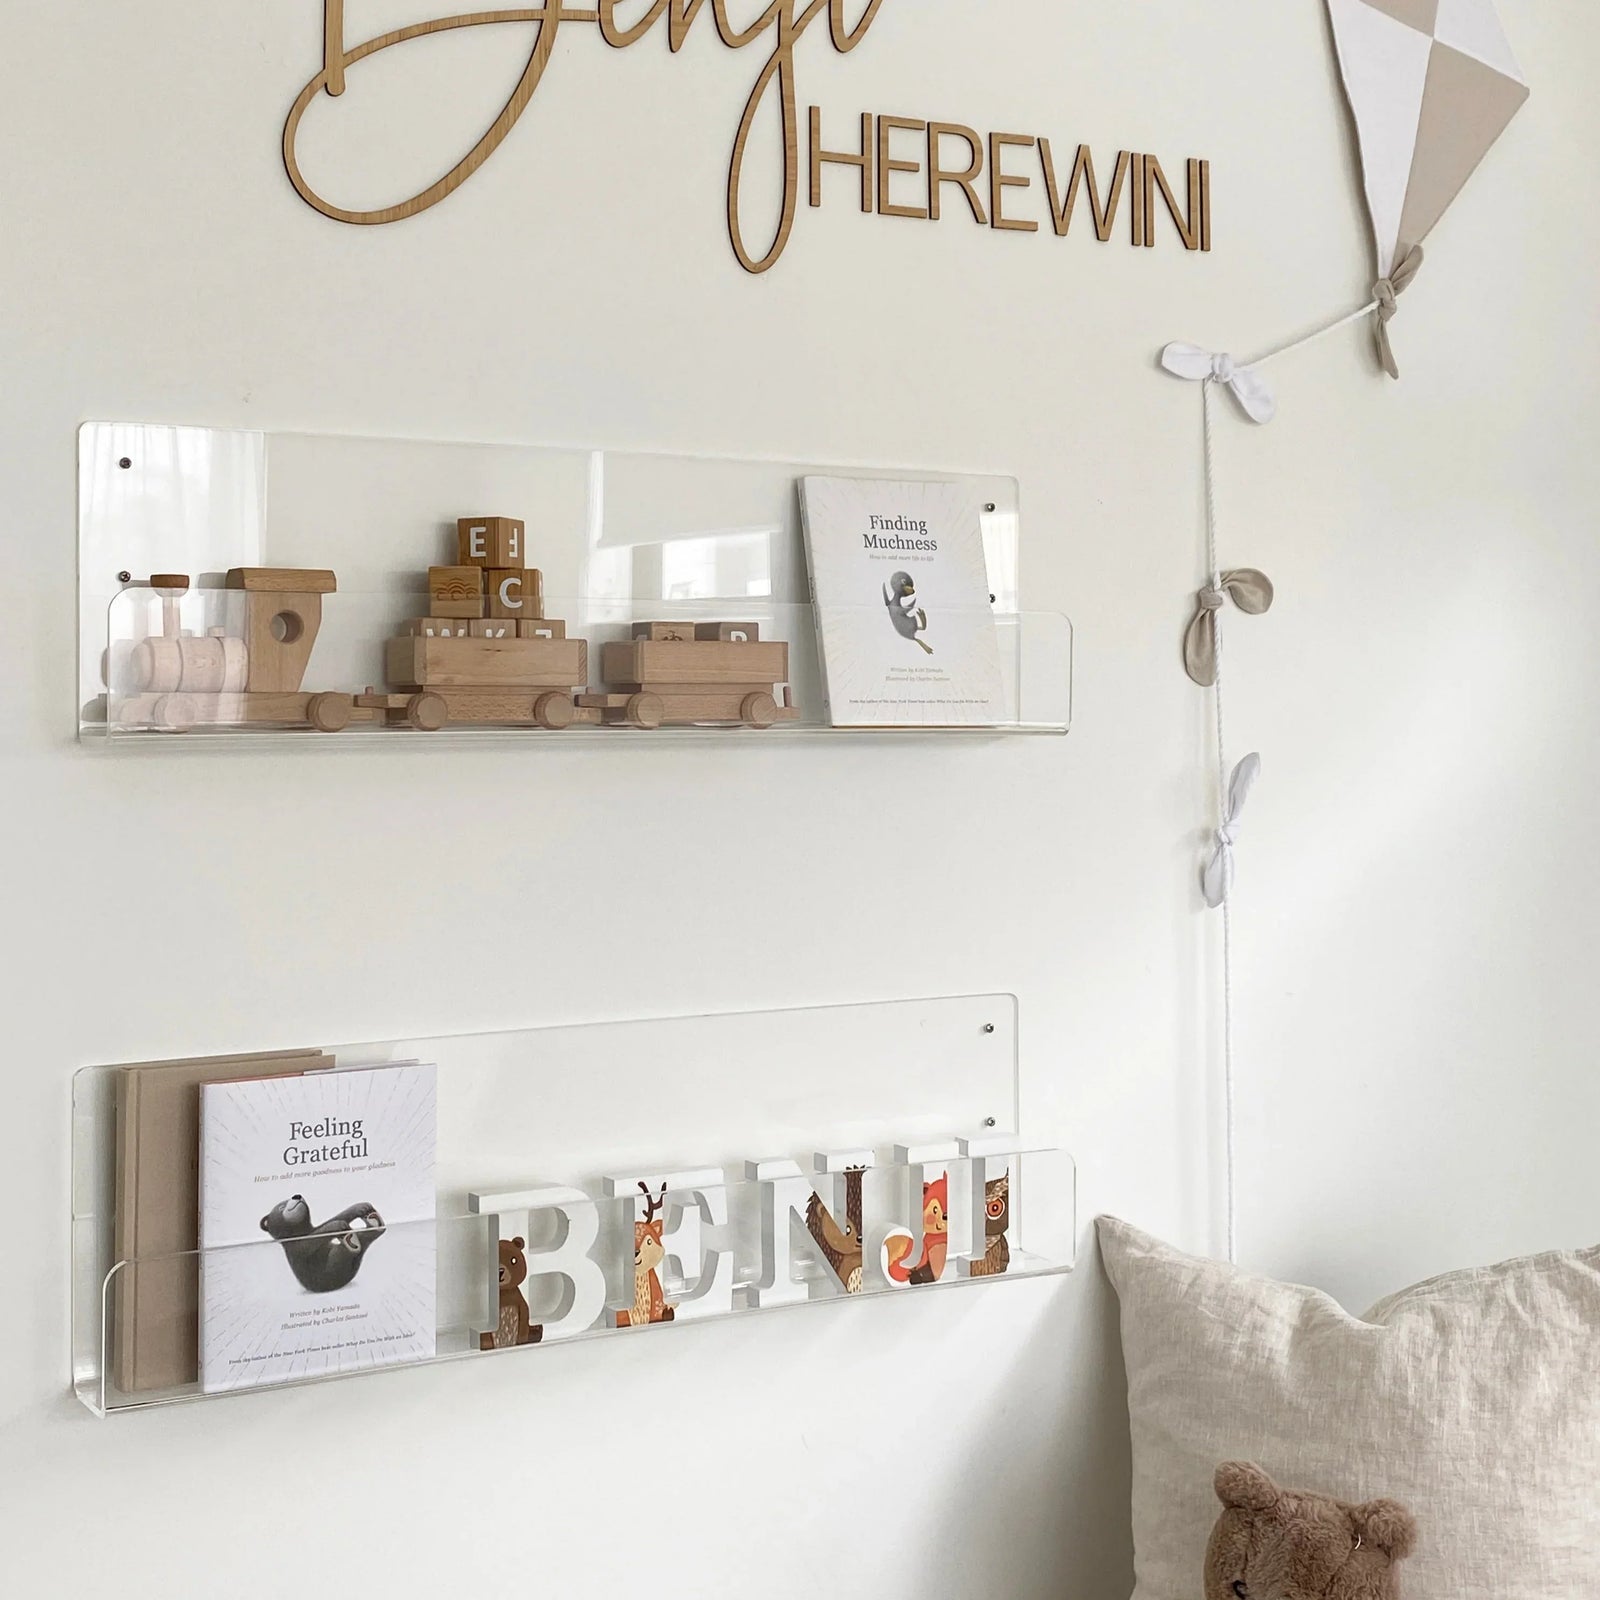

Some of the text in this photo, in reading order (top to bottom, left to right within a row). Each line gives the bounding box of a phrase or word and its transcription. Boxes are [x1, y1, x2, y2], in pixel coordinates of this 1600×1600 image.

[809, 105, 1212, 252] HEREWINI
[869, 514, 928, 535] Finding
[469, 526, 487, 557] E
[862, 533, 938, 551] Muchness
[499, 577, 523, 609] C
[289, 1117, 364, 1141] Feeling
[283, 1137, 369, 1166] Grateful
[254, 1174, 270, 1183] How
[280, 1171, 293, 1180] add
[294, 1171, 311, 1179] more
[469, 1138, 1018, 1351] BENJI
